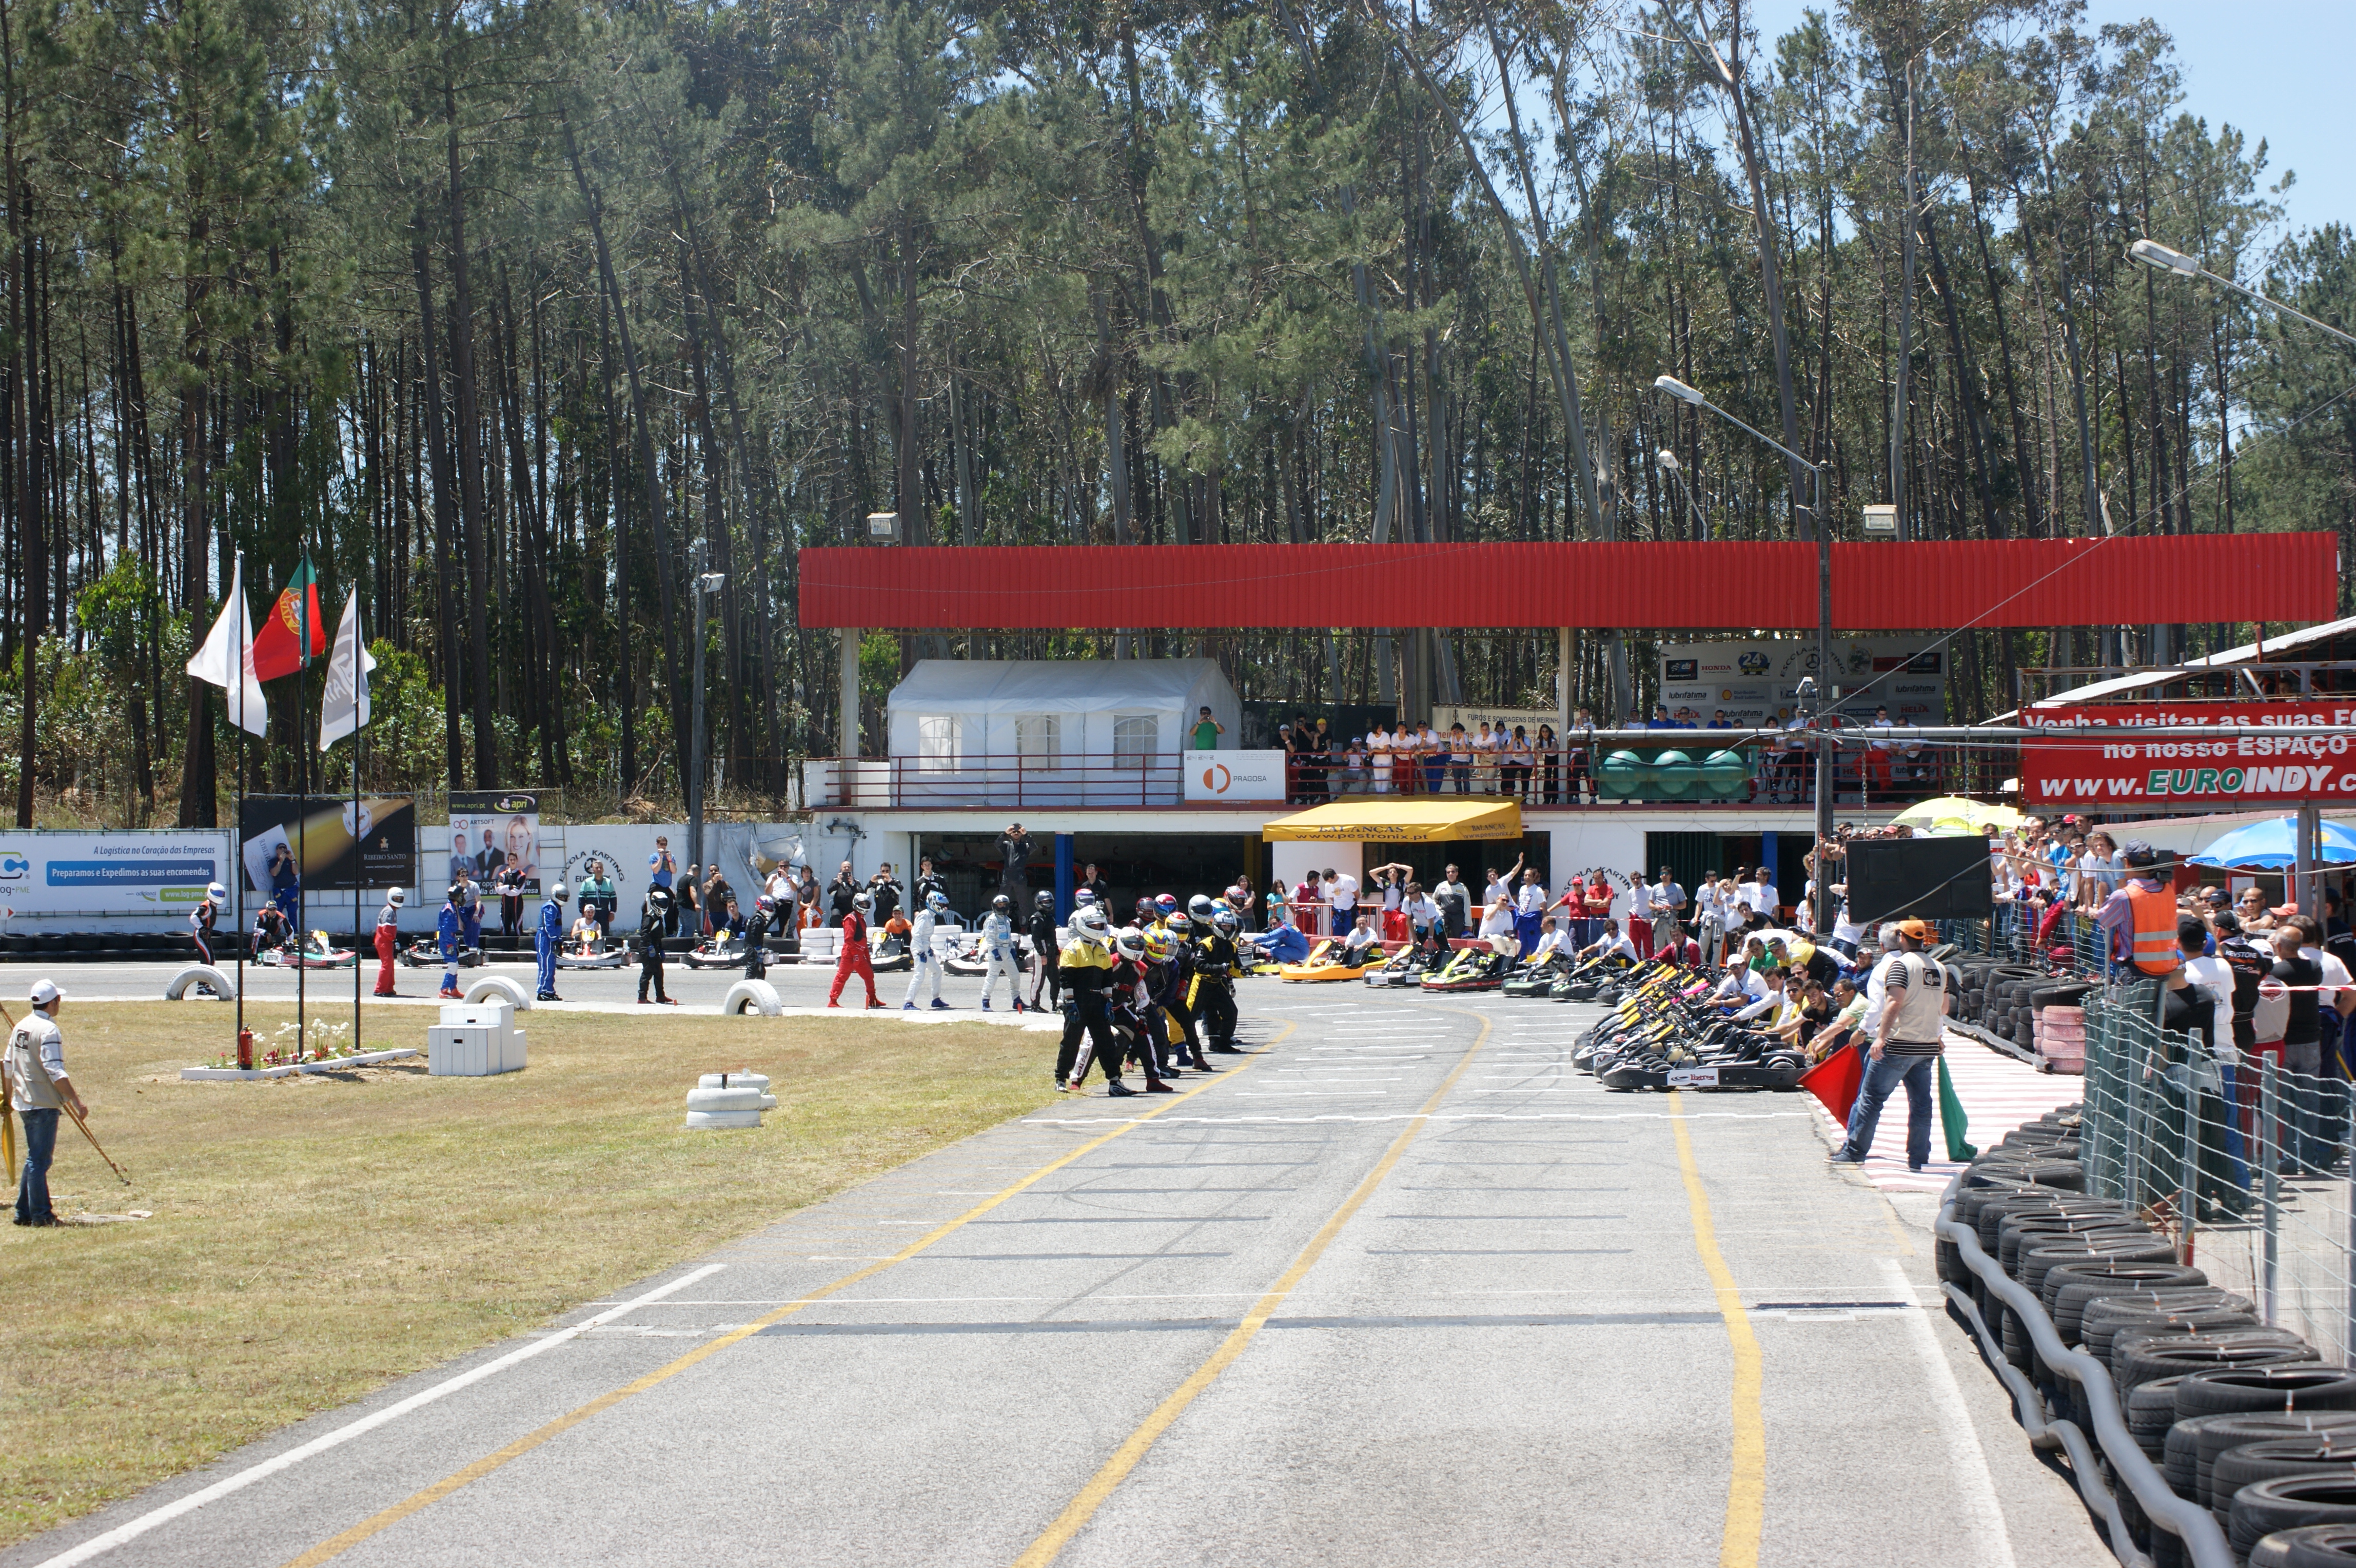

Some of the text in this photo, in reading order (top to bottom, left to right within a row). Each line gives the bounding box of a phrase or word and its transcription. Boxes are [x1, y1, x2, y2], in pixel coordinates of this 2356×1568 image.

[1743, 653, 1761, 665] 24
[1493, 715, 1526, 723] SONDAGENS
[2118, 713, 2208, 726] visitar
[2261, 714, 2325, 726] suas
[2104, 735, 2348, 759] no nosso ESPAÇO
[512, 799, 528, 810] apri
[1471, 823, 1506, 831] BALANÇAS
[1296, 833, 1428, 841] www.pestronix.pt
[100, 847, 130, 856] Logística
[142, 846, 168, 856] Coração
[170, 846, 182, 854] das
[183, 846, 215, 855] Empresas
[559, 850, 625, 882] ESCOLA KARTING
[52, 868, 94, 879] Preparamos
[102, 868, 140, 879] Expedimos
[167, 867, 209, 876] encomendas
[1599, 867, 1632, 890] KARTIN
[0, 887, 30, 896] og-PME
[2225, 950, 2257, 958] KEYSTONE
